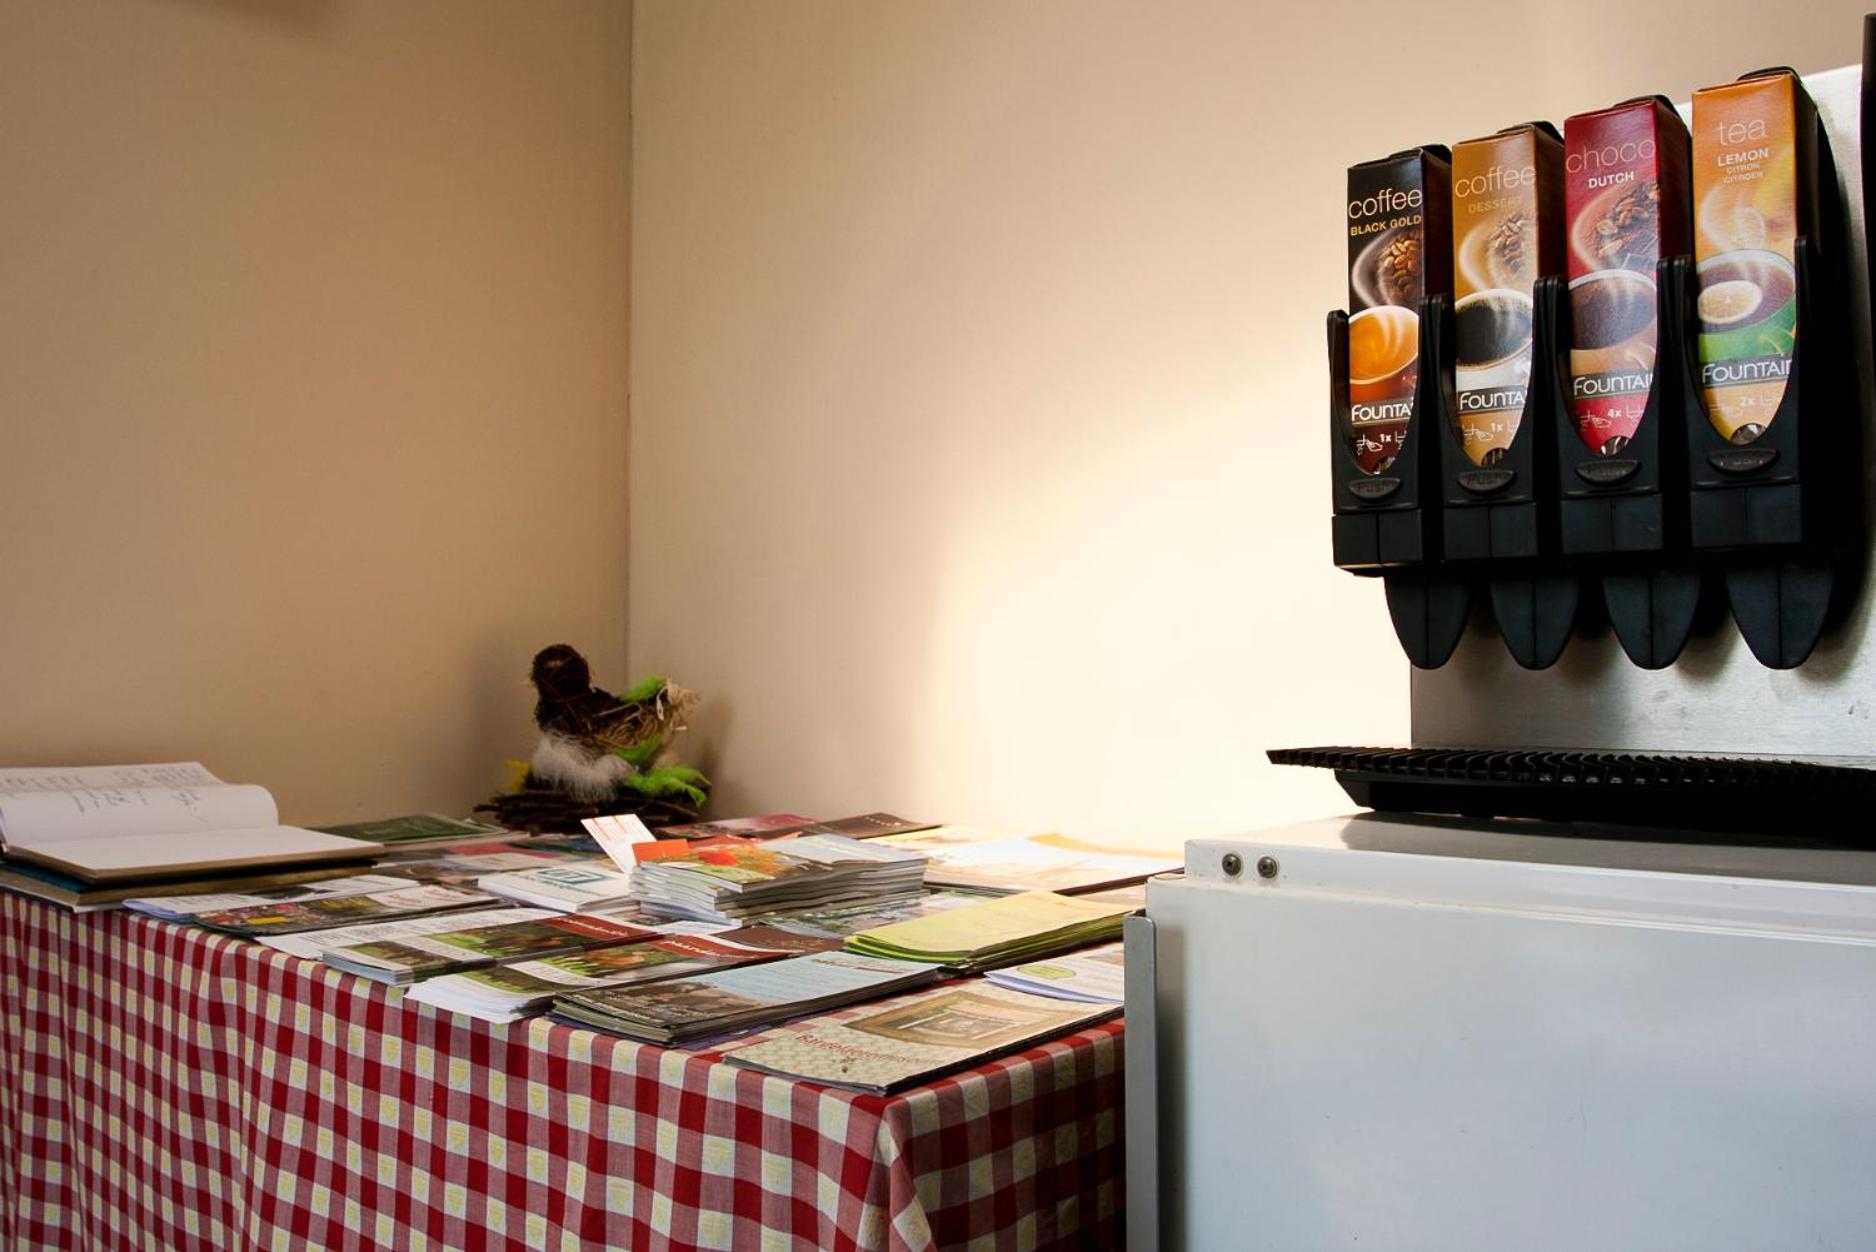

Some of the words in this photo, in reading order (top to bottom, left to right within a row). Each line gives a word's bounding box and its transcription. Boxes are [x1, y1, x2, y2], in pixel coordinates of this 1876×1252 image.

[1716, 119, 1768, 146] tea
[1566, 139, 1656, 173] choco
[1716, 148, 1769, 168] LEMON
[1455, 165, 1536, 198] coffee
[1588, 171, 1635, 189] DUTCH
[1348, 188, 1423, 219] coffee
[1350, 221, 1387, 236] BLACK
[1390, 214, 1422, 229] GOLD
[1460, 391, 1526, 410] FOUNTA
[1351, 402, 1412, 422] FOUNTA
[1608, 408, 1622, 418] 4x
[1490, 422, 1503, 433] 1x
[1380, 433, 1392, 443] 1x
